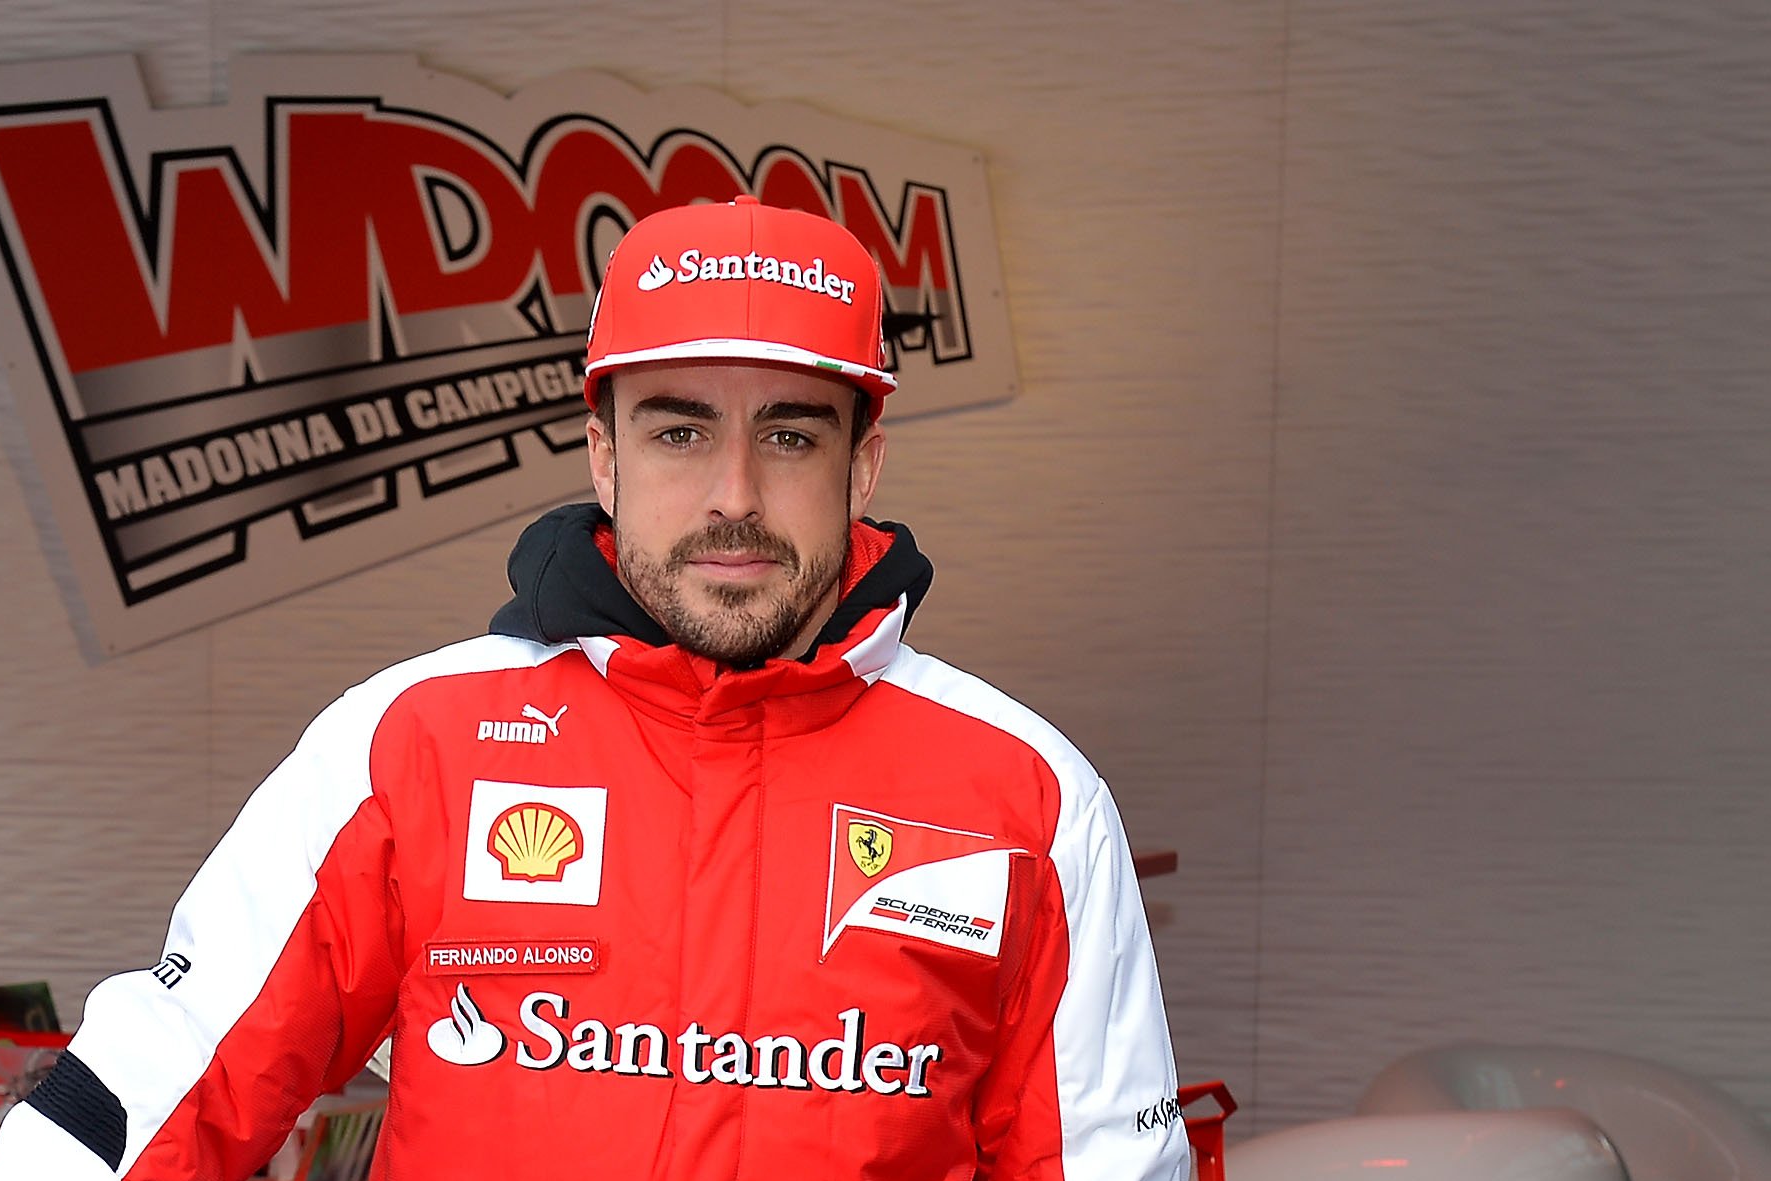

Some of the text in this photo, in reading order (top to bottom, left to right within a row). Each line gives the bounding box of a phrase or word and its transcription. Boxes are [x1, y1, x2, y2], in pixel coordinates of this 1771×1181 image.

[676, 249, 855, 304] Santander
[95, 359, 585, 519] MADONNA DI CAMPIGL
[478, 719, 546, 744] PUMA
[875, 897, 970, 924] SCUDERIA
[909, 914, 988, 940] FERRARI
[430, 945, 593, 967] FERNANDO ALONSO
[516, 991, 941, 1098] Santander
